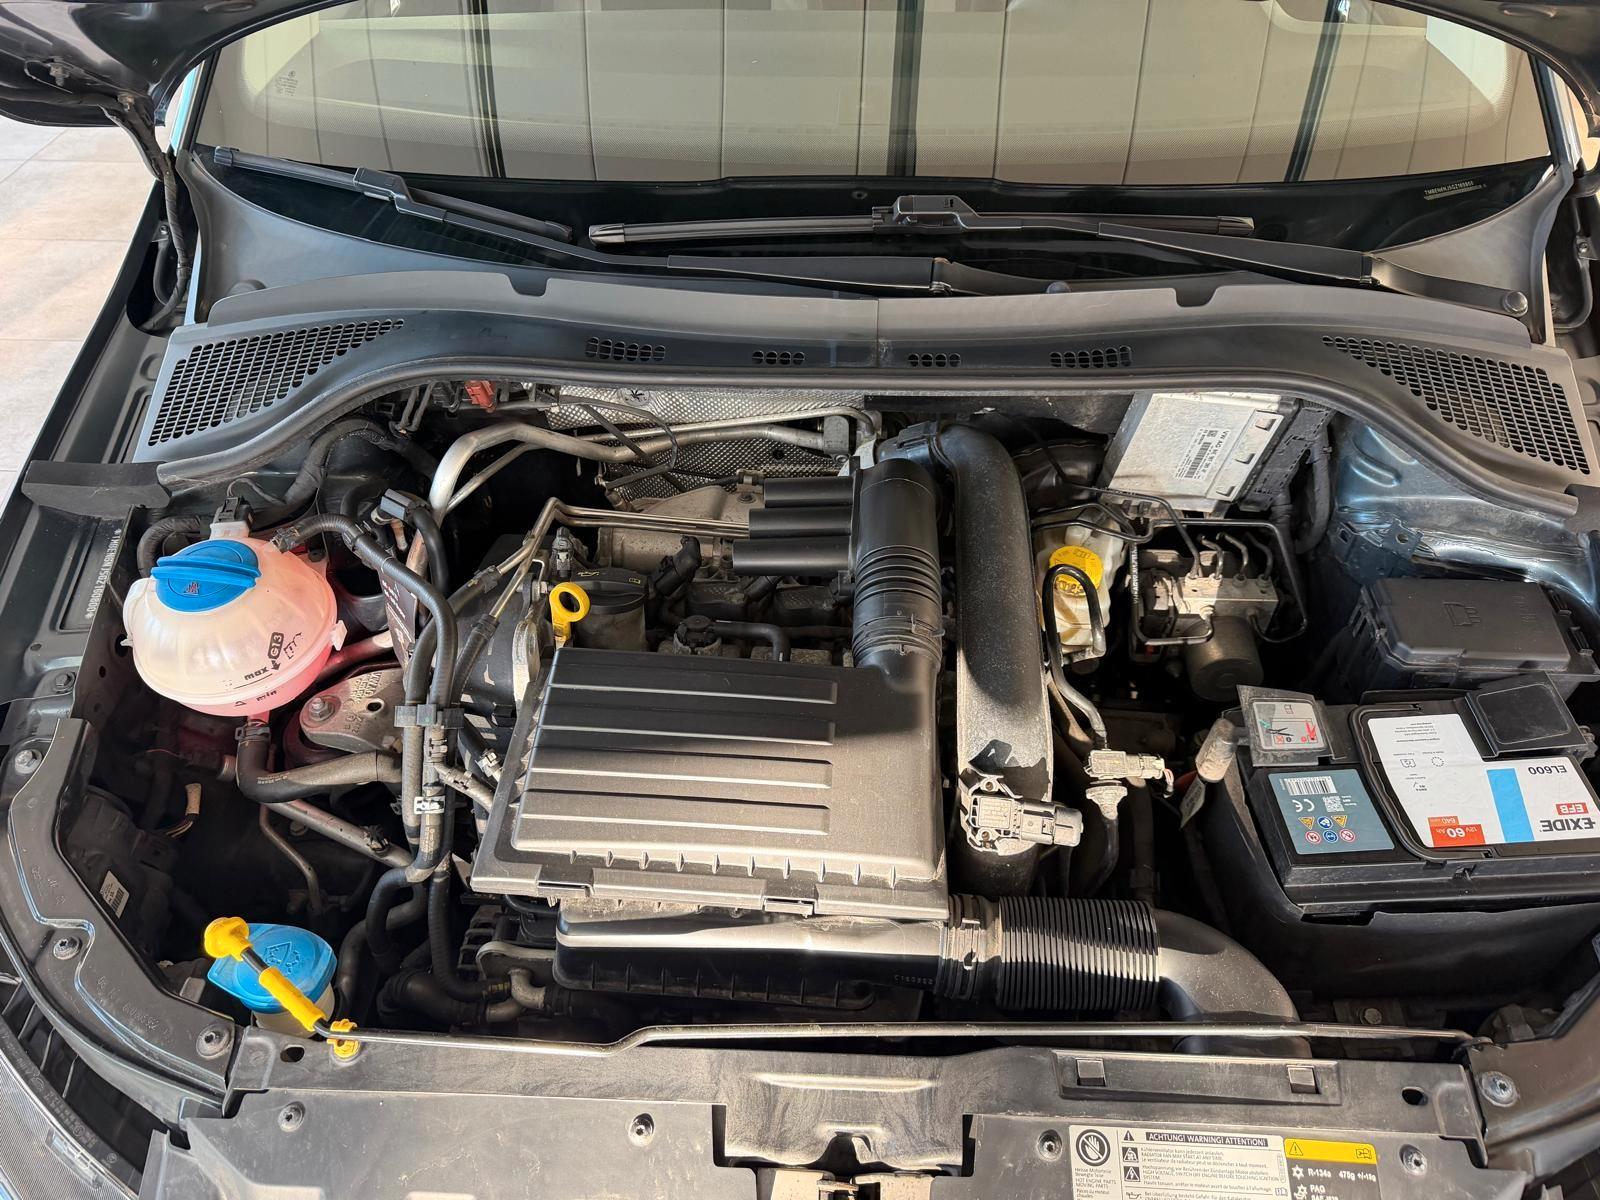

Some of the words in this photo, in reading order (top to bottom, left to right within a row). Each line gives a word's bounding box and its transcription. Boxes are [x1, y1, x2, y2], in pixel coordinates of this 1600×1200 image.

[270, 633, 283, 657] G13
[243, 666, 270, 681] max
[255, 690, 278, 702] min
[1528, 764, 1567, 775] EL600
[1559, 803, 1584, 814] EFB
[1541, 817, 1597, 832] EXIDE
[1446, 827, 1466, 838] 60
[1149, 1133, 1186, 1142] ACHTUNG!
[1187, 1135, 1224, 1144] WARNING!
[1225, 1137, 1266, 1147] ATTENTION!
[1307, 1168, 1332, 1178] R-134a
[1309, 1184, 1326, 1193] PAG
